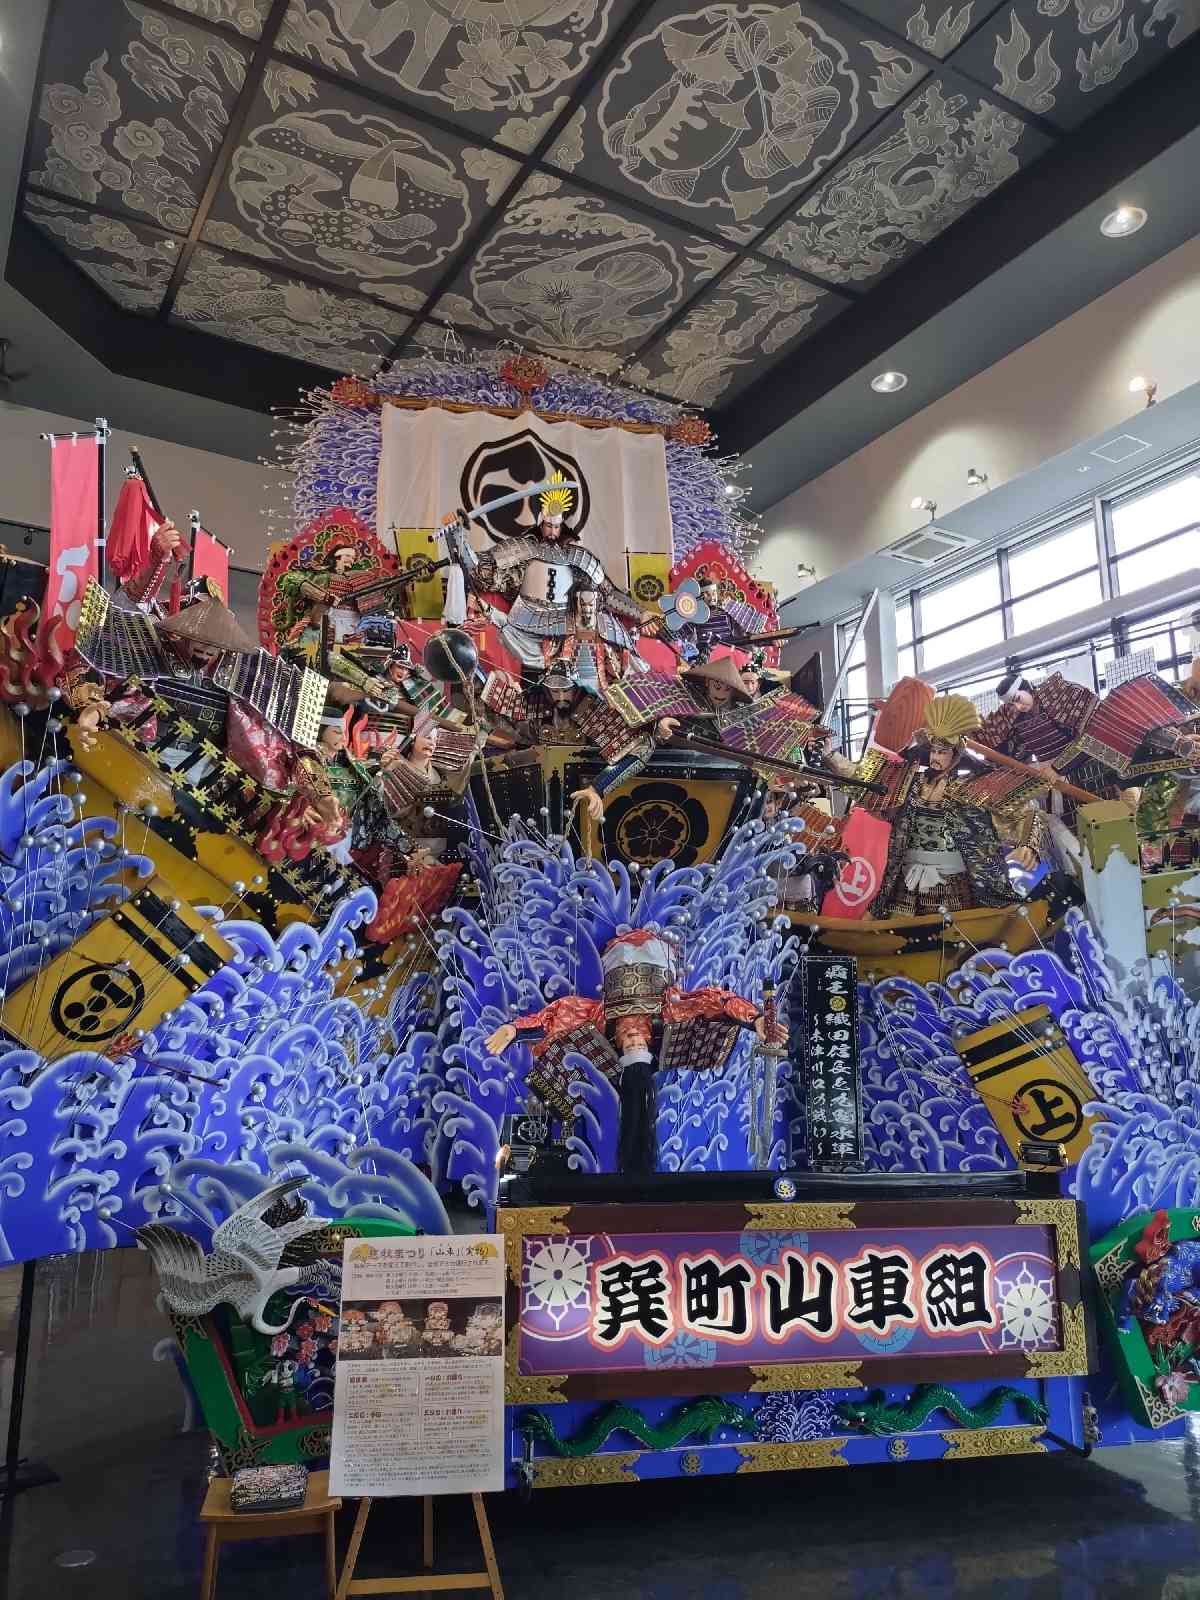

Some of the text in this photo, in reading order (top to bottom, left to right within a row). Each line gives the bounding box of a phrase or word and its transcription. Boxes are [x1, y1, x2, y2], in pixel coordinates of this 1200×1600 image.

[598, 1249, 994, 1341] 巽町山車組
